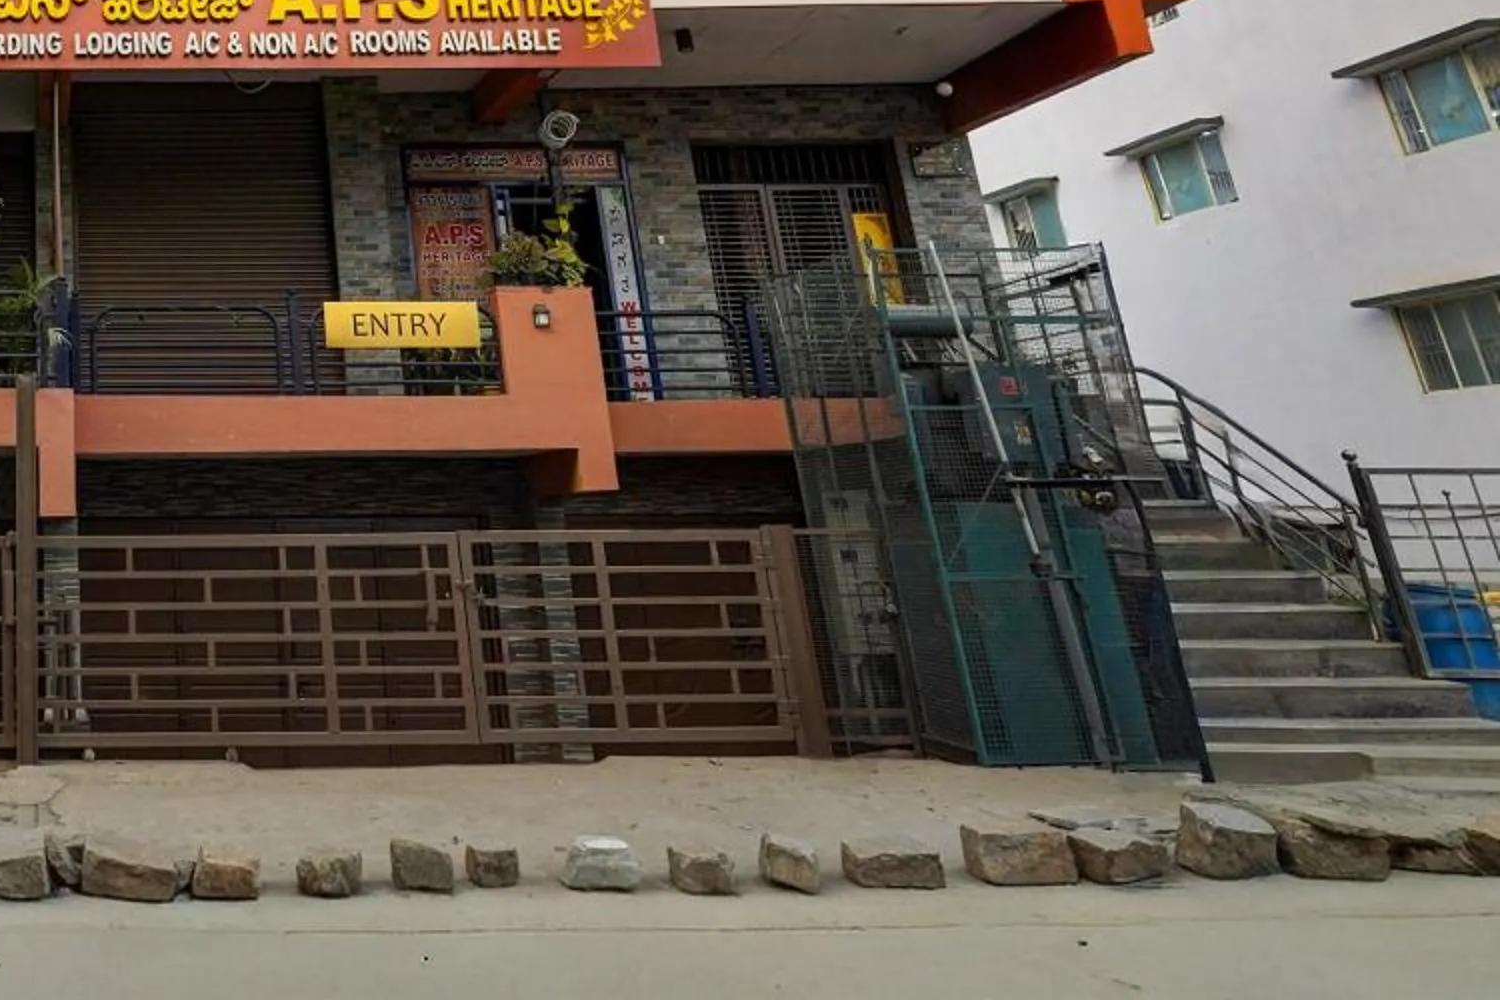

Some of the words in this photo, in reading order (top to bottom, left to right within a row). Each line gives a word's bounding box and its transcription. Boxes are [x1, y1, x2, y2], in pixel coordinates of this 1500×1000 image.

[74, 32, 172, 56] LODGING
[185, 31, 220, 56] A/C
[228, 31, 243, 55] &
[251, 31, 296, 55] NON
[304, 31, 339, 55] A/C
[351, 30, 431, 55] ROOMS
[440, 28, 562, 54] AVAILABLE
[425, 225, 484, 245] A.P.S
[352, 311, 447, 337] ENTRY
